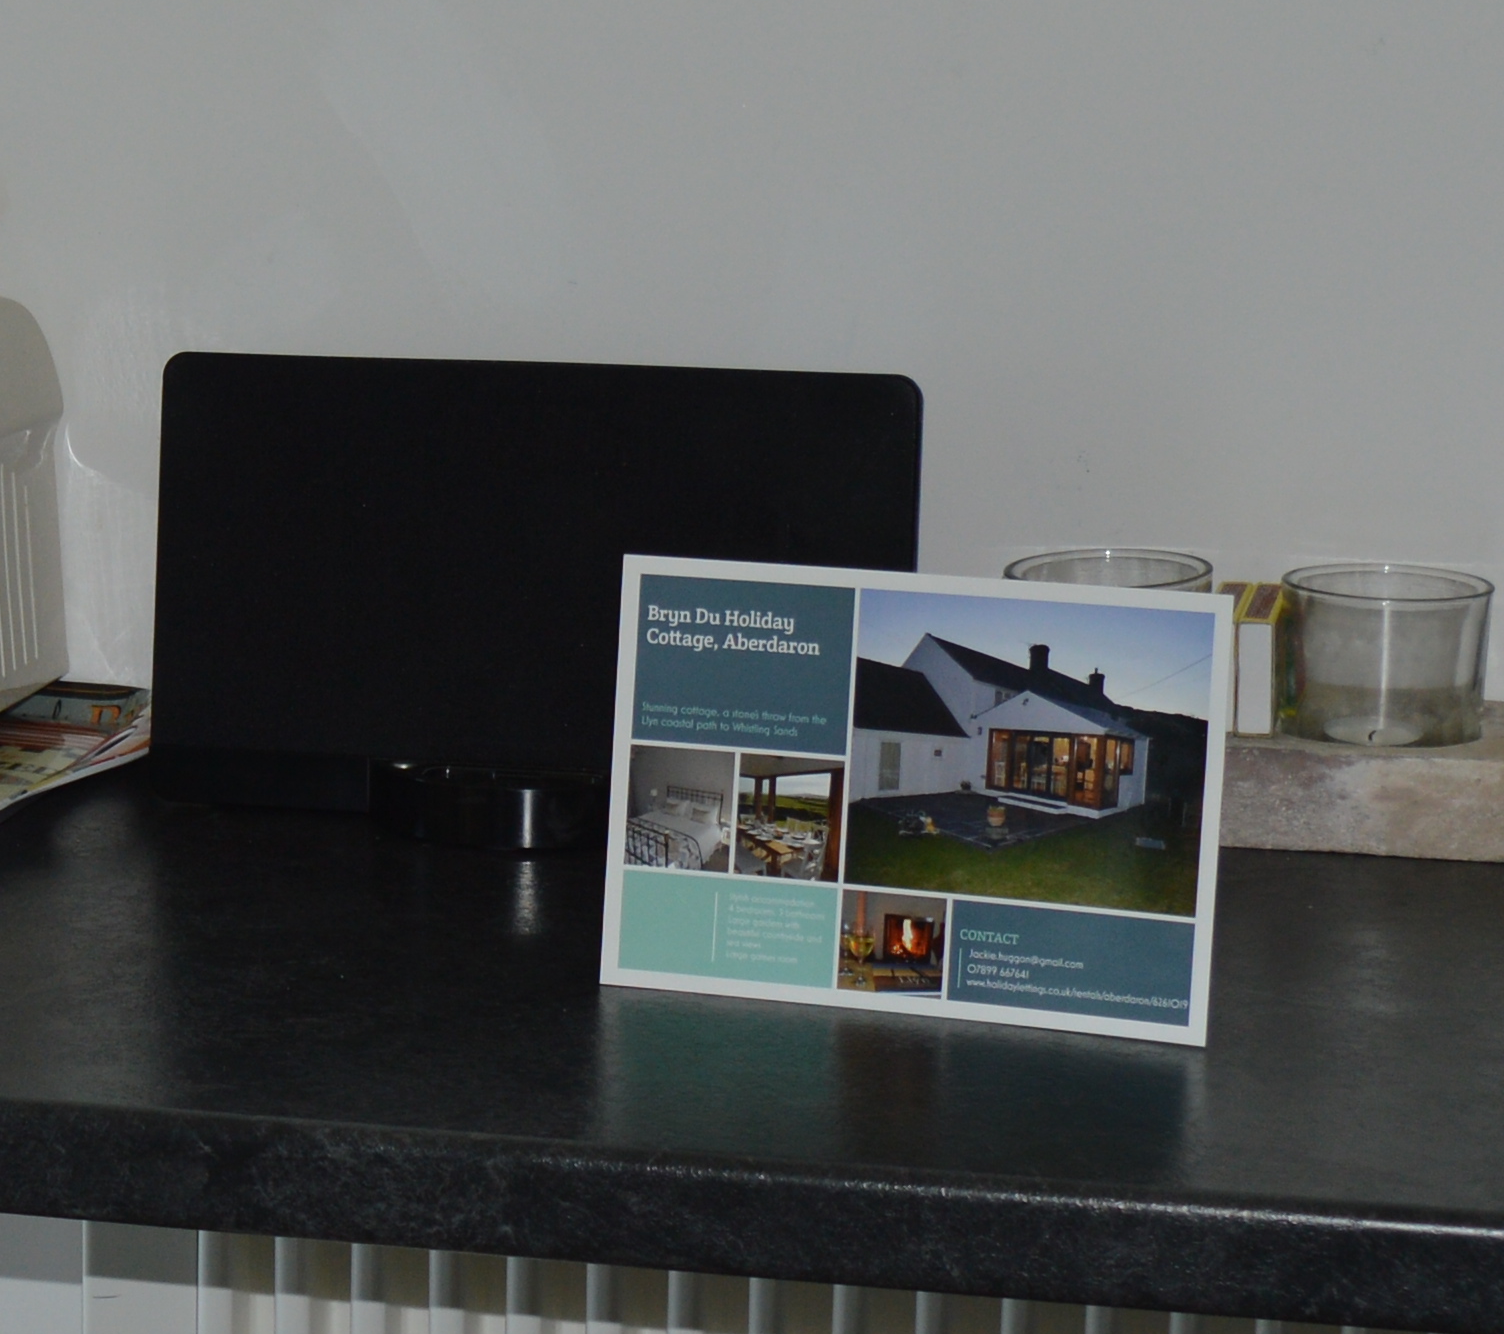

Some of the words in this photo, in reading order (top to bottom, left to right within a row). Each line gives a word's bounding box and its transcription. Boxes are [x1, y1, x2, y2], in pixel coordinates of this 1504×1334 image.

[647, 605, 692, 627] Bryn
[695, 608, 721, 625] Du
[724, 610, 795, 634] Holiday
[646, 628, 719, 652] Cottage,
[722, 633, 821, 656] Aberdaron
[642, 701, 678, 716] Stunning
[761, 711, 787, 722] throw
[788, 712, 810, 723] from
[811, 713, 828, 725] the
[660, 718, 694, 729] coastal
[696, 720, 718, 732] path
[720, 721, 731, 731] to
[732, 723, 770, 737] Whistling
[773, 725, 798, 737] Sands
[960, 929, 1020, 945] CONTACT
[967, 964, 998, 976] 07899
